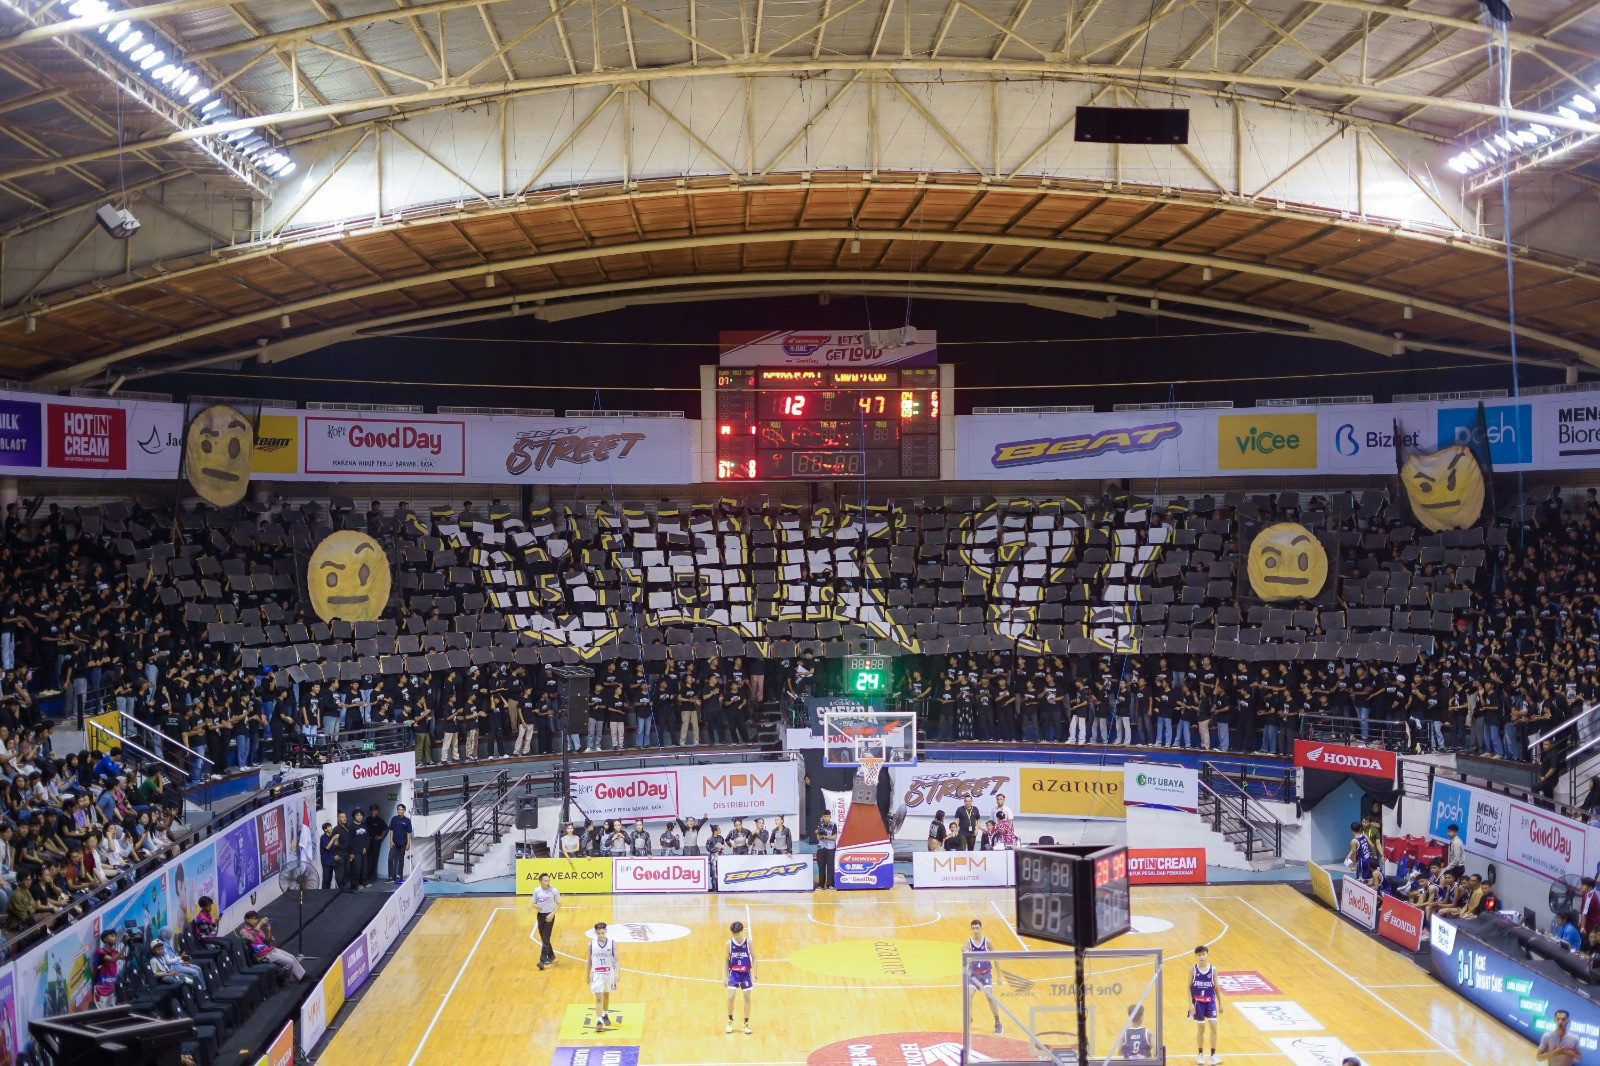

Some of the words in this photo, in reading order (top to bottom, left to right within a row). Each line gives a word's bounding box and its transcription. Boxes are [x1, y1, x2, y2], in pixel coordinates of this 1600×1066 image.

[837, 335, 863, 346] LET'S
[825, 349, 849, 361] GET
[848, 347, 883, 362] LOUD
[784, 394, 806, 415] 12
[858, 396, 886, 414] 47
[1454, 411, 1516, 446] posh
[64, 436, 110, 457] CREAM
[993, 424, 1179, 464] BEAT
[505, 432, 647, 476] STREET
[856, 672, 879, 690] 24
[1323, 752, 1383, 770] HONDA
[702, 773, 774, 798] MPM
[904, 776, 1011, 808] STREET
[1147, 776, 1157, 786] RS
[1157, 777, 1185, 789] UBAYA
[712, 800, 765, 810] DISTRIBUTOR
[837, 797, 846, 823] CREAM
[1435, 794, 1465, 830] posh
[933, 856, 987, 872] MPM
[1157, 857, 1197, 870] CREAM
[525, 871, 604, 881] AZWEAR.COM
[723, 862, 808, 885] BEAT
[1390, 915, 1417, 936] HONDA
[599, 958, 606, 966] 11
